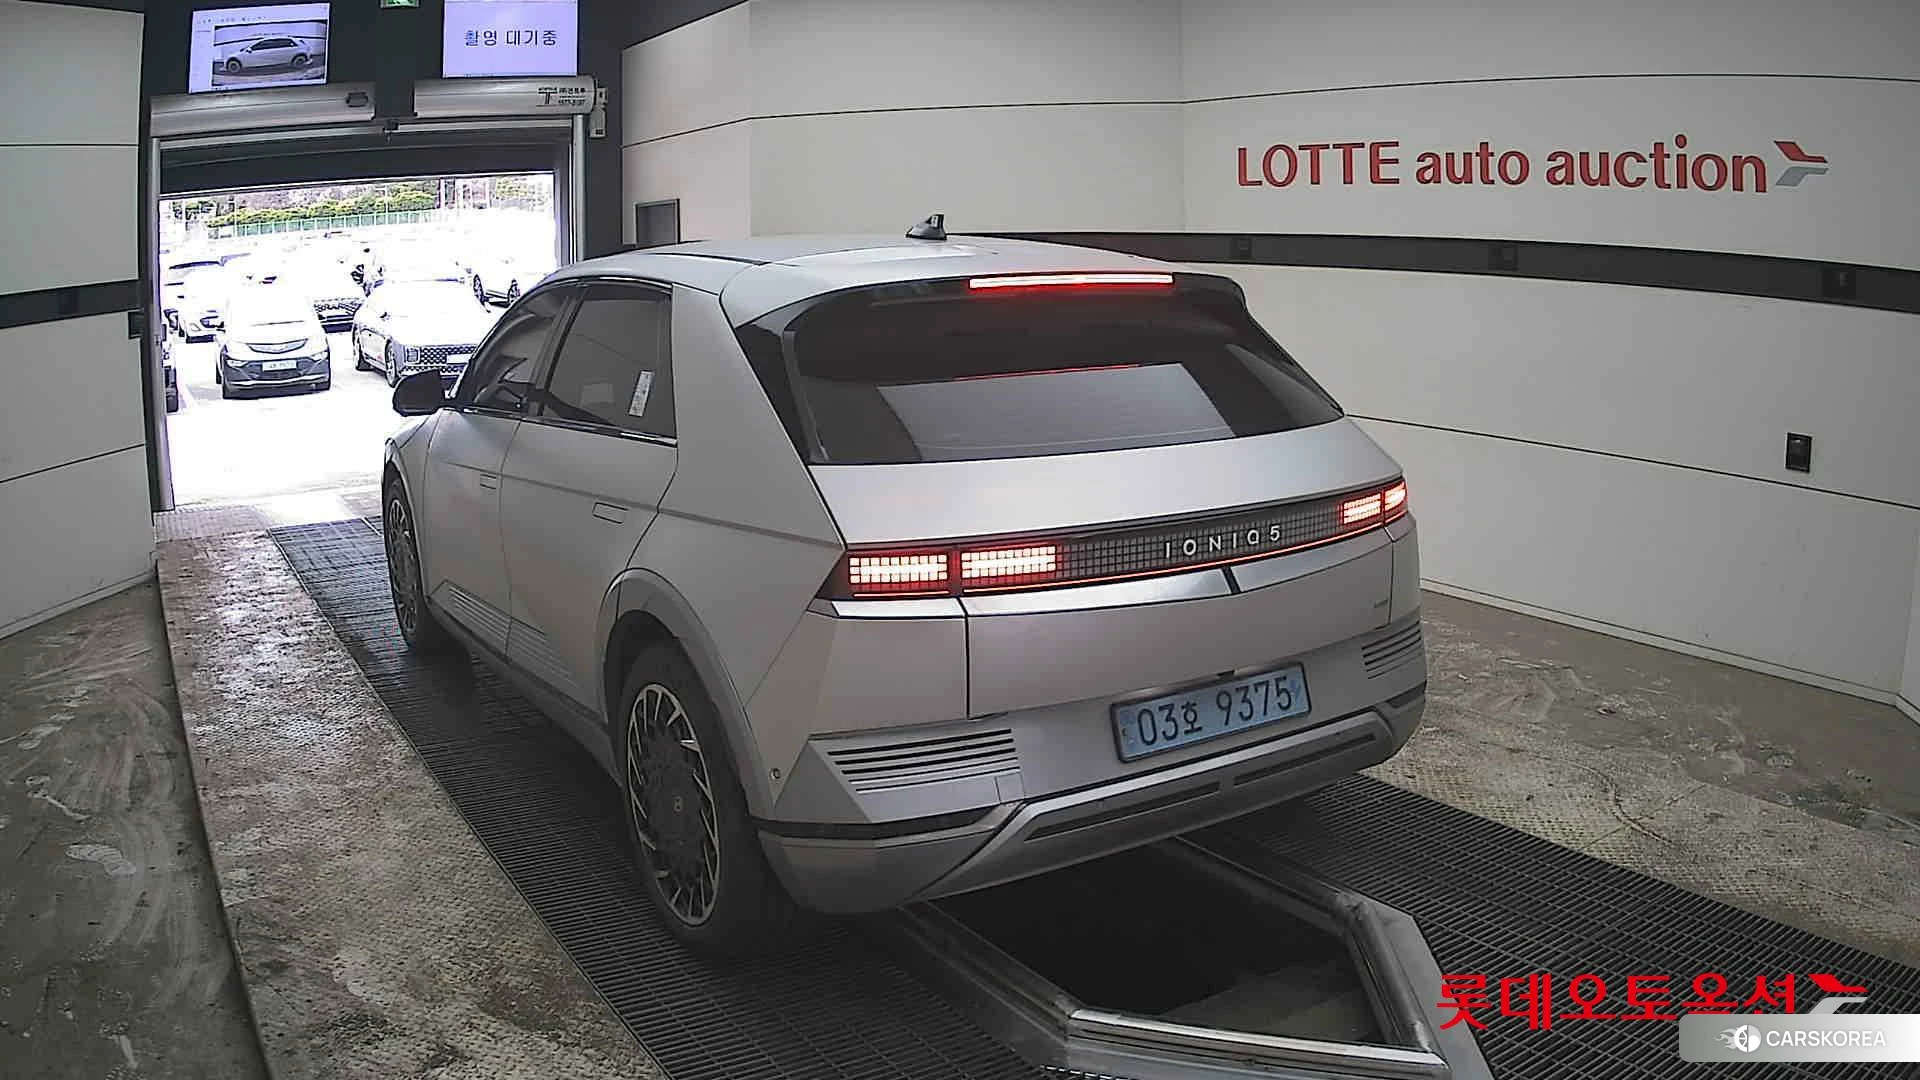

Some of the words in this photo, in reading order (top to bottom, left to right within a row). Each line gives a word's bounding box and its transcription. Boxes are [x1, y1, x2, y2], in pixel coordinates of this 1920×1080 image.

[464, 29, 498, 46] 촬영
[505, 29, 558, 47] 대기중
[1237, 140, 1400, 188] LOTTE
[1415, 141, 1531, 186] auto
[1545, 134, 1768, 193] auction
[1136, 701, 1203, 746] 03호
[1215, 675, 1292, 726] 9375
